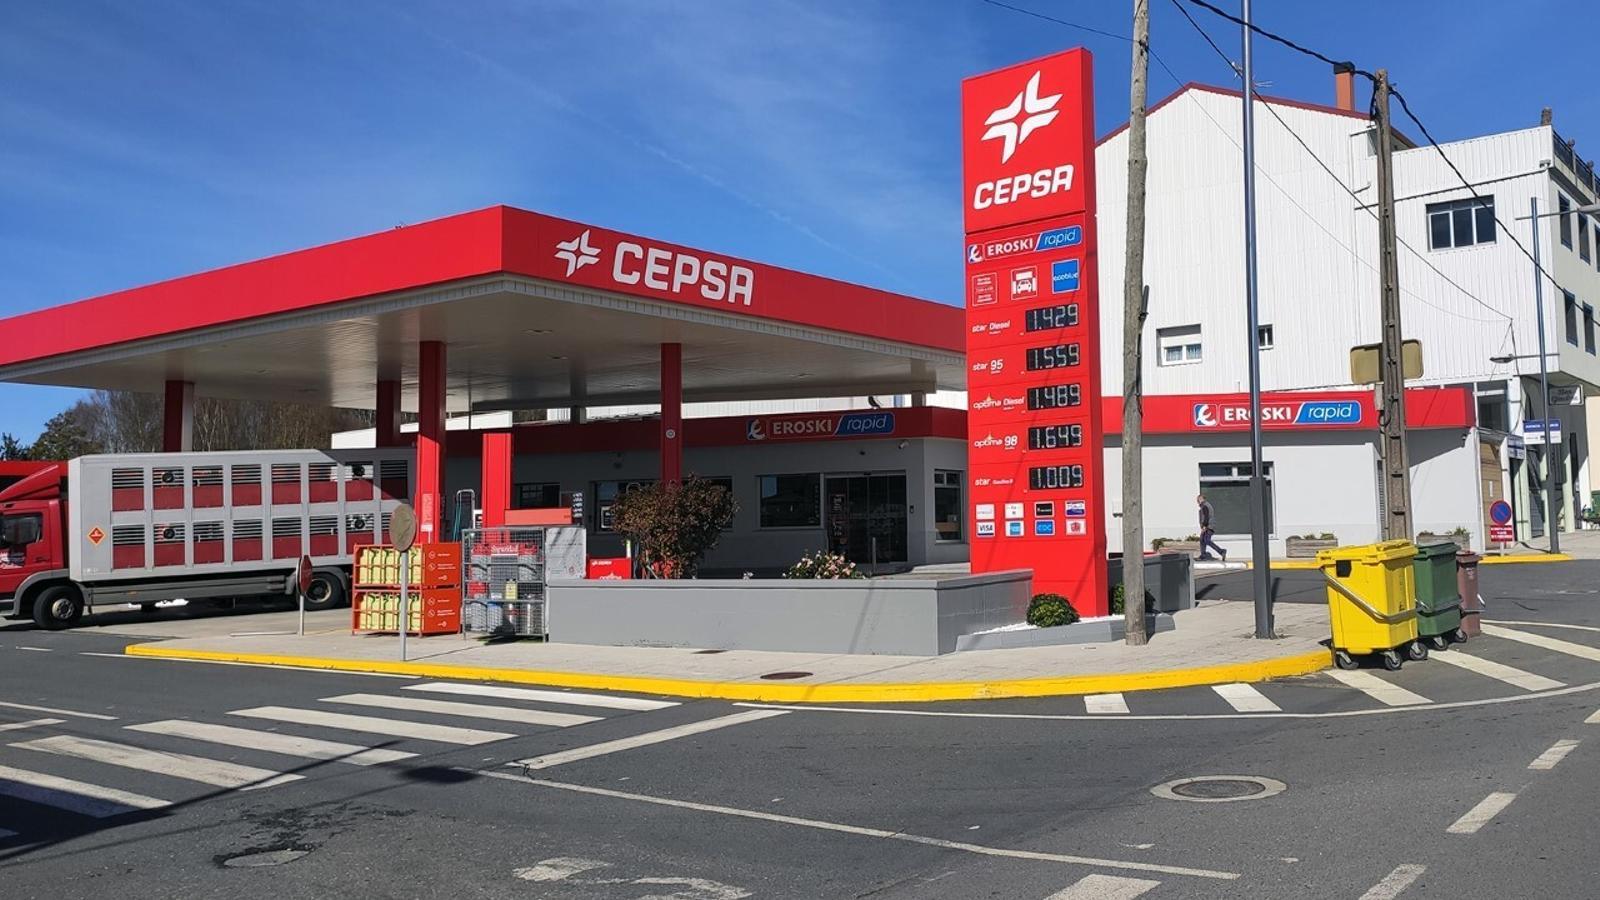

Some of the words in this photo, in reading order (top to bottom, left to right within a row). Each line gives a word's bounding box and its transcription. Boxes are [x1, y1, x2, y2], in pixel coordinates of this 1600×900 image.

[972, 164, 1074, 210] CEPSA
[987, 238, 1034, 258] EROSKI
[1044, 229, 1076, 250] rapid
[612, 241, 754, 306] CEPSA
[1033, 303, 1079, 330] 1.429
[990, 359, 1004, 371] 95
[1035, 343, 1080, 369] 1.559
[1035, 384, 1081, 409] 1.489
[1223, 407, 1292, 421] ERSKI
[1308, 404, 1353, 421] rapid
[772, 419, 832, 435] EROSKI
[846, 415, 887, 432] rapid
[1036, 425, 1082, 449] 1.649
[1004, 435, 1018, 446] 98
[975, 478, 991, 486] star
[1038, 465, 1083, 489] 1.009
[979, 524, 993, 532] VISA
